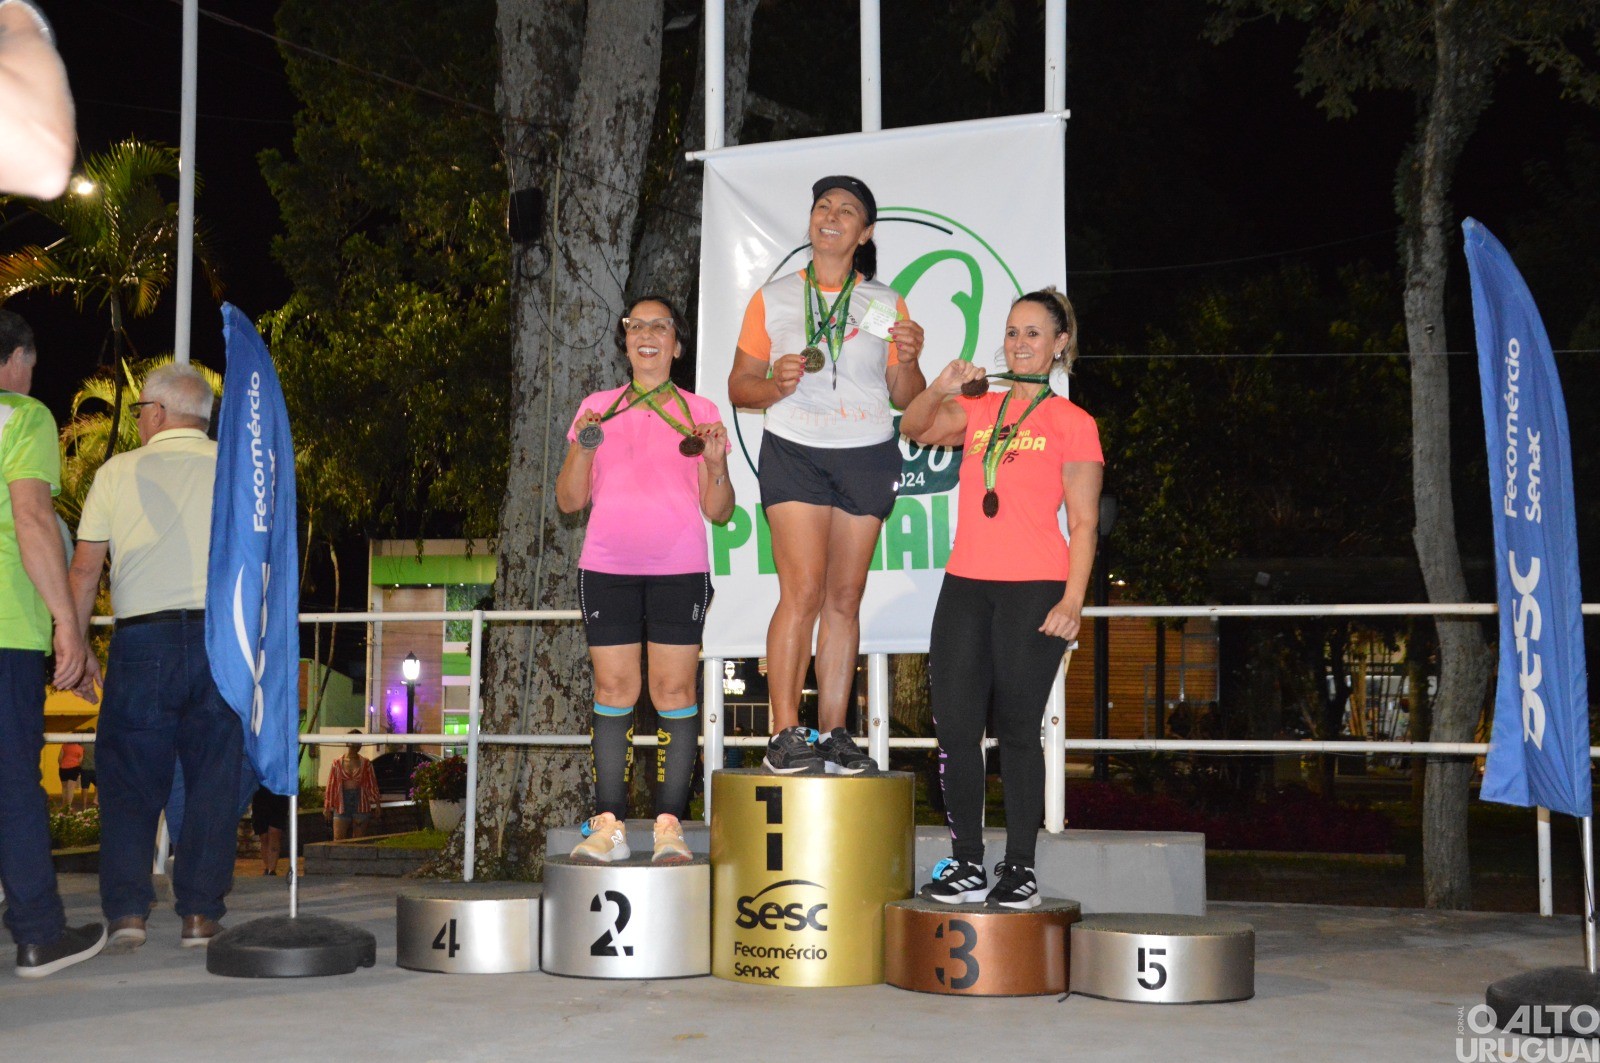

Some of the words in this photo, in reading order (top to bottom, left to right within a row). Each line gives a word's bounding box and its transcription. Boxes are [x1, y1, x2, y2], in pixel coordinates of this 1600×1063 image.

[247, 371, 268, 532] Fecomércio
[1503, 337, 1520, 519] Fecomércio
[1524, 426, 1542, 524] Senac
[755, 786, 783, 871] 1
[432, 919, 460, 958] 4
[590, 890, 634, 956] 2
[735, 894, 828, 932] Sesc
[734, 942, 828, 961] Fecomércio
[734, 962, 780, 980] Senac
[935, 919, 980, 990] 3
[1137, 947, 1167, 990] 5
